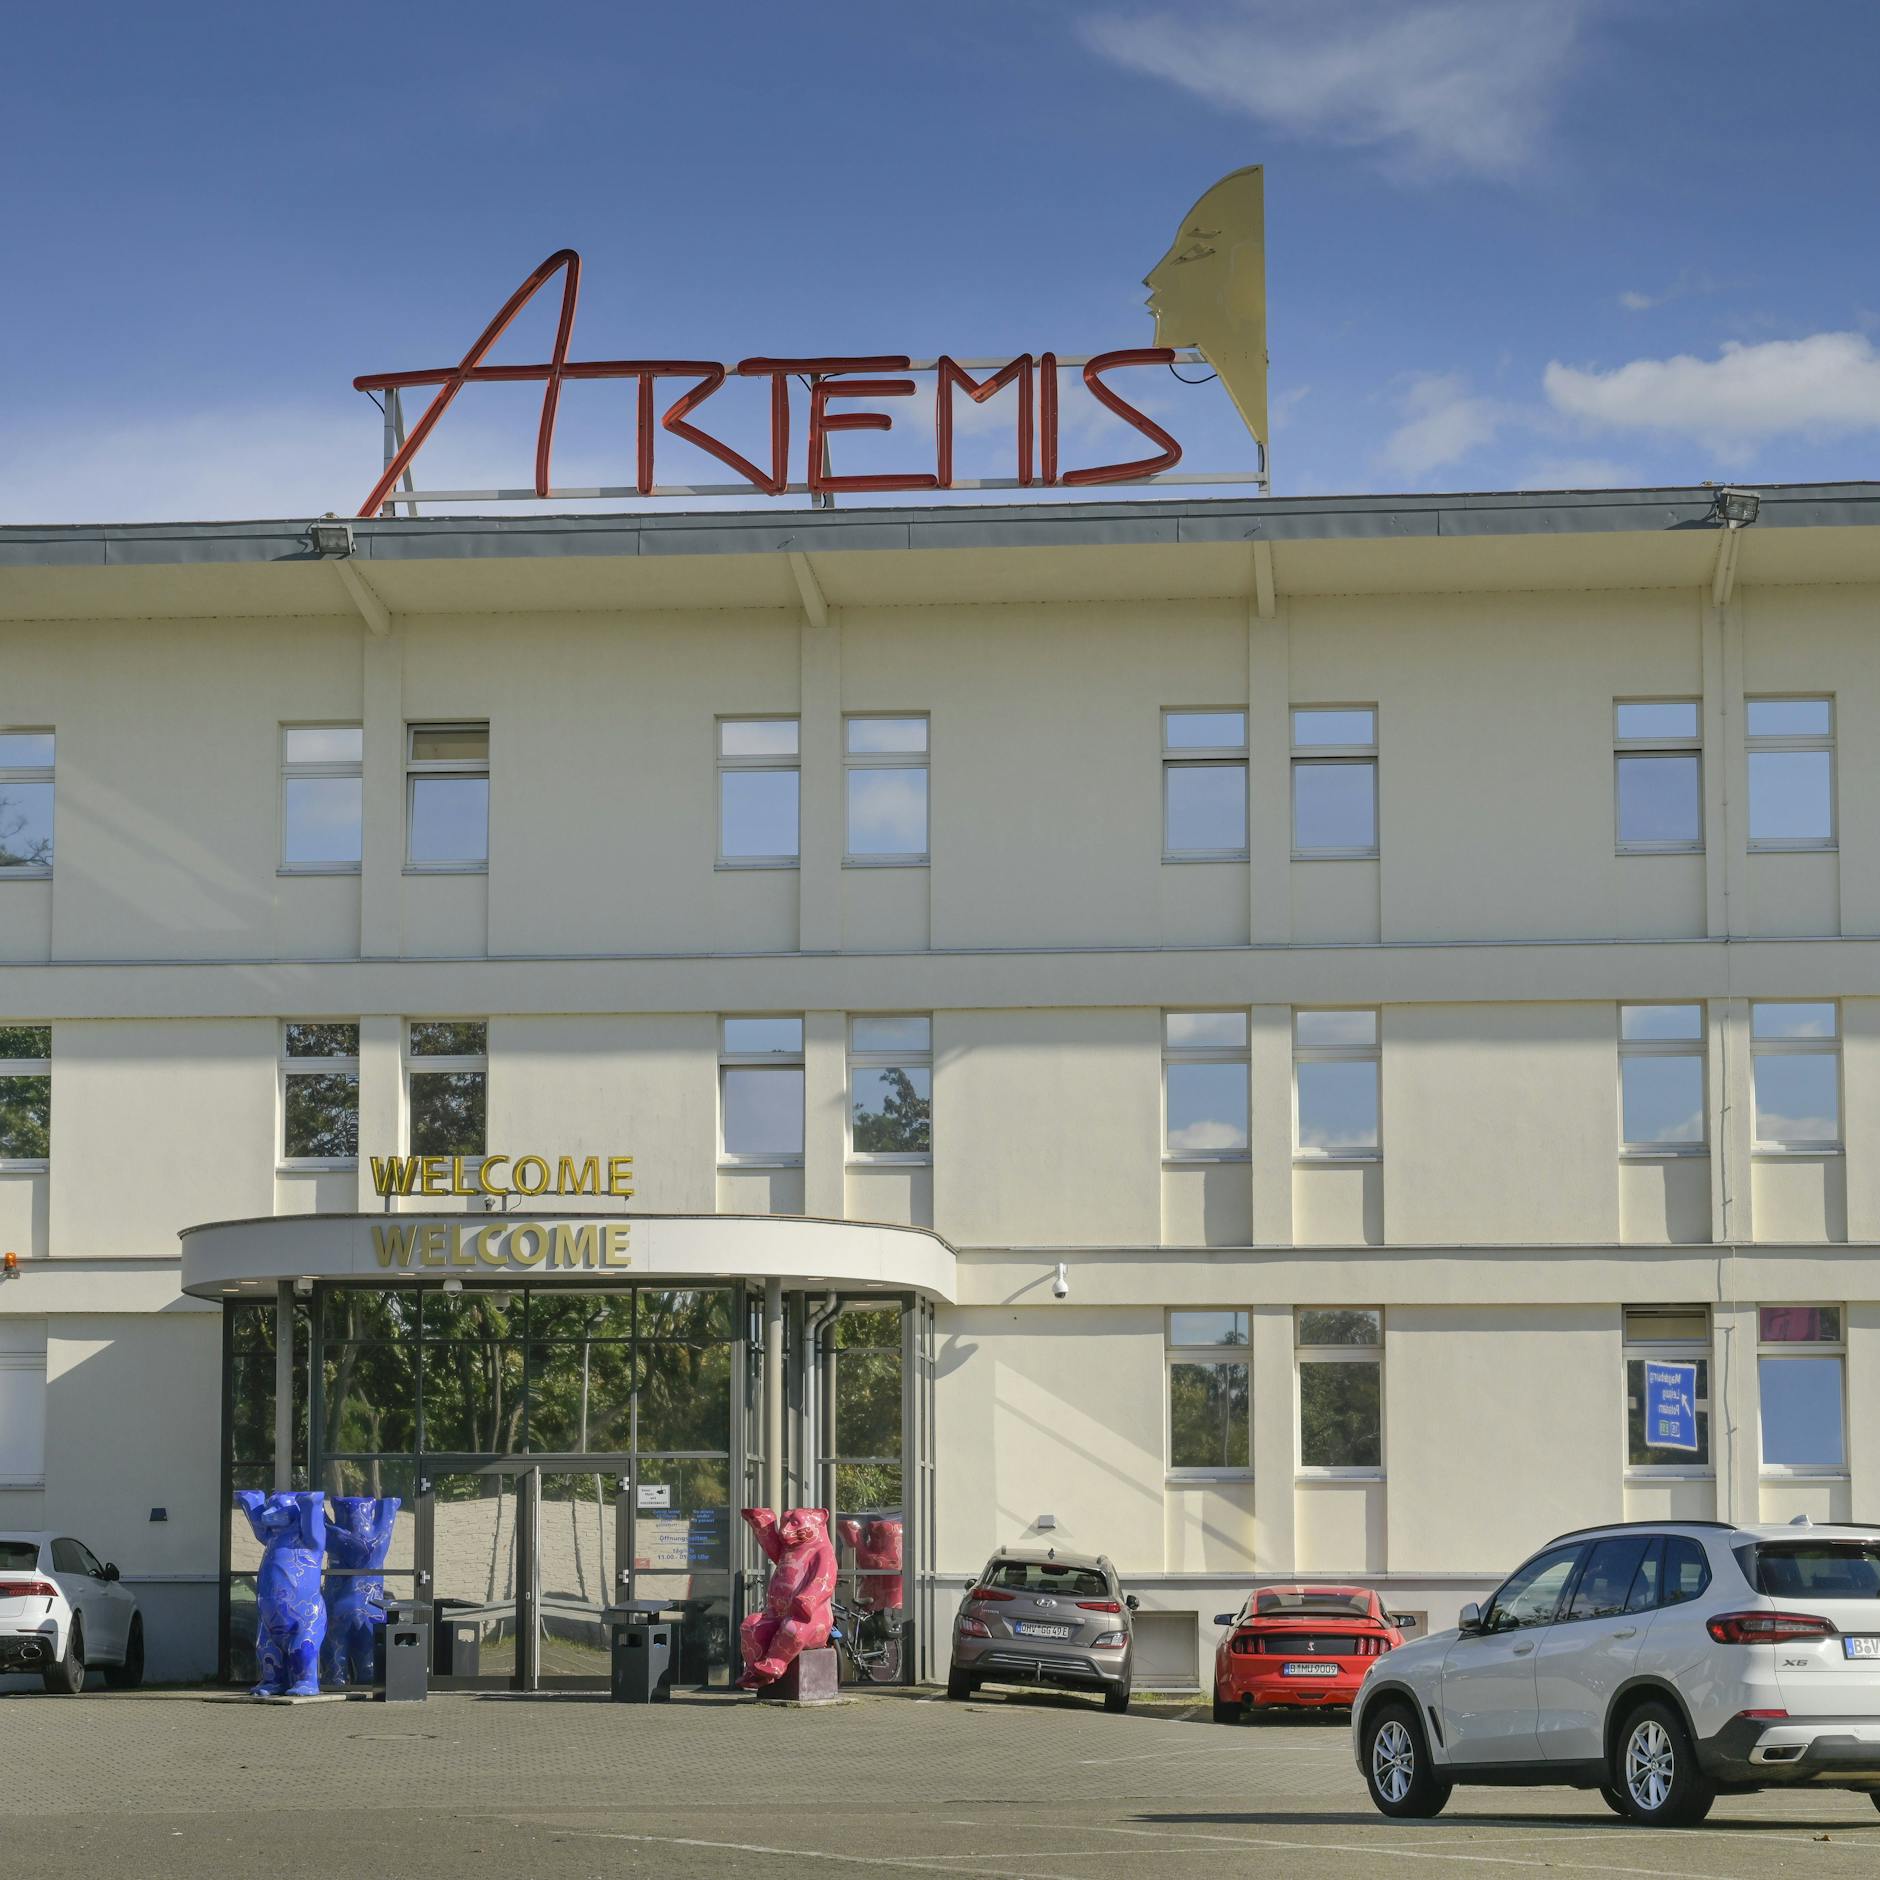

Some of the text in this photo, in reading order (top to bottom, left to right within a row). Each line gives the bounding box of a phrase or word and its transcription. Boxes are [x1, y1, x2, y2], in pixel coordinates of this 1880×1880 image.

[353, 249, 1182, 517] ARTEMIS
[370, 1155, 635, 1196] WELCOME
[371, 1223, 631, 1267] WELCOME
[1855, 1639, 1863, 1654] B
